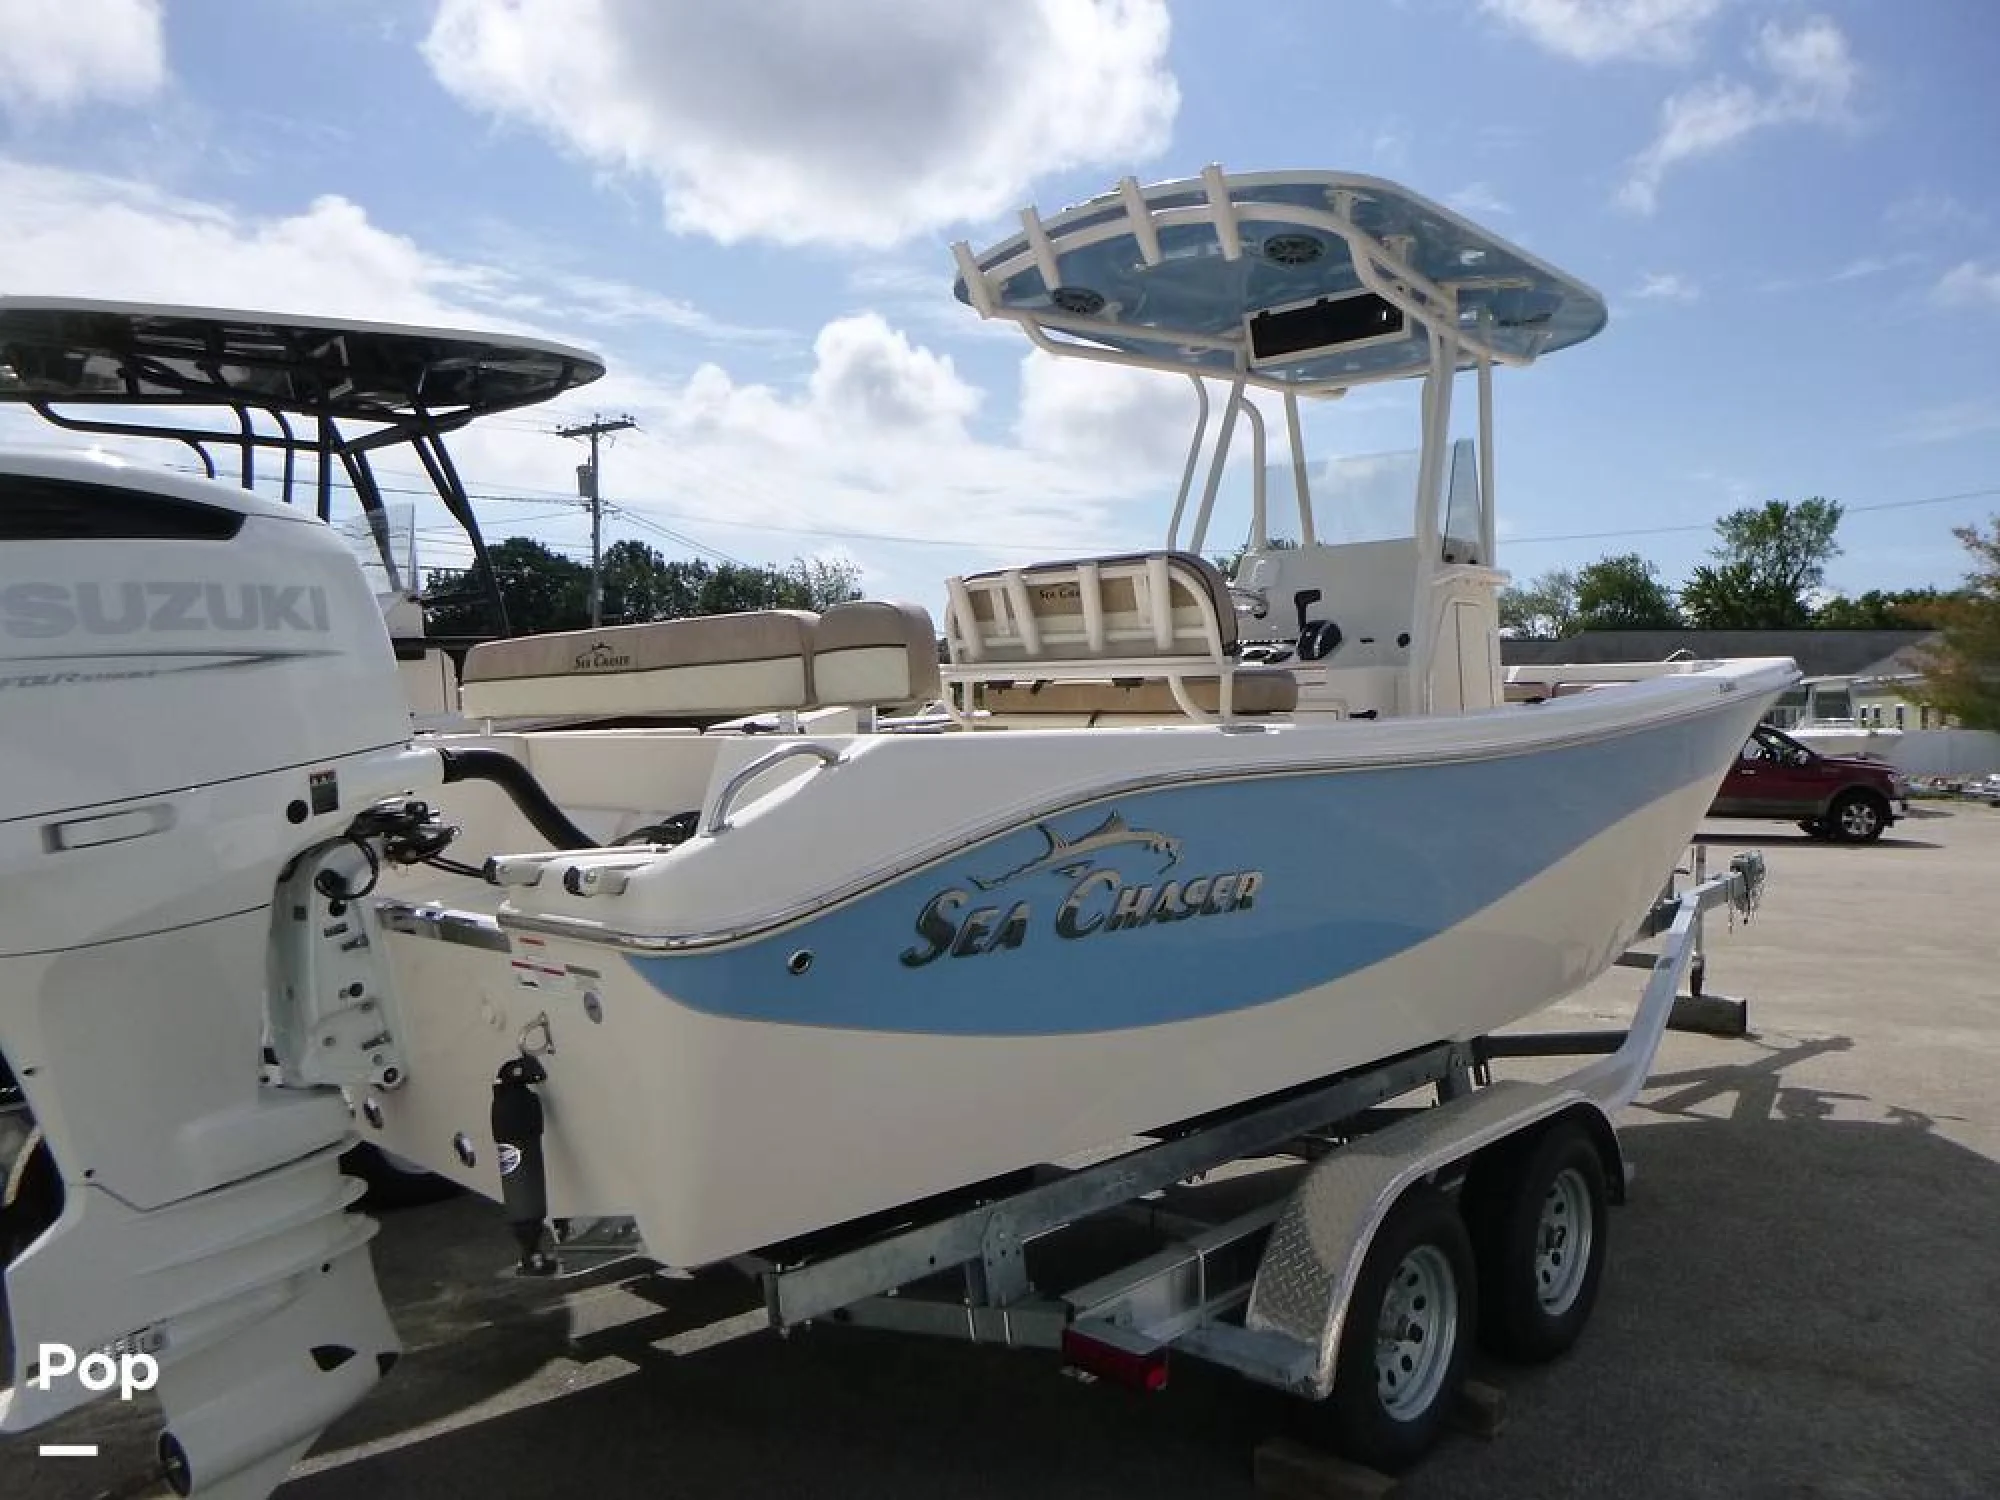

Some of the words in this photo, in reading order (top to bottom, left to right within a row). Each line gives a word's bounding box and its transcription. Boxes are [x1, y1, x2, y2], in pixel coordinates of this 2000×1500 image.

[2, 581, 331, 639] SUZUKI
[900, 888, 1031, 968] SEA
[1054, 868, 1264, 940] CHASER
